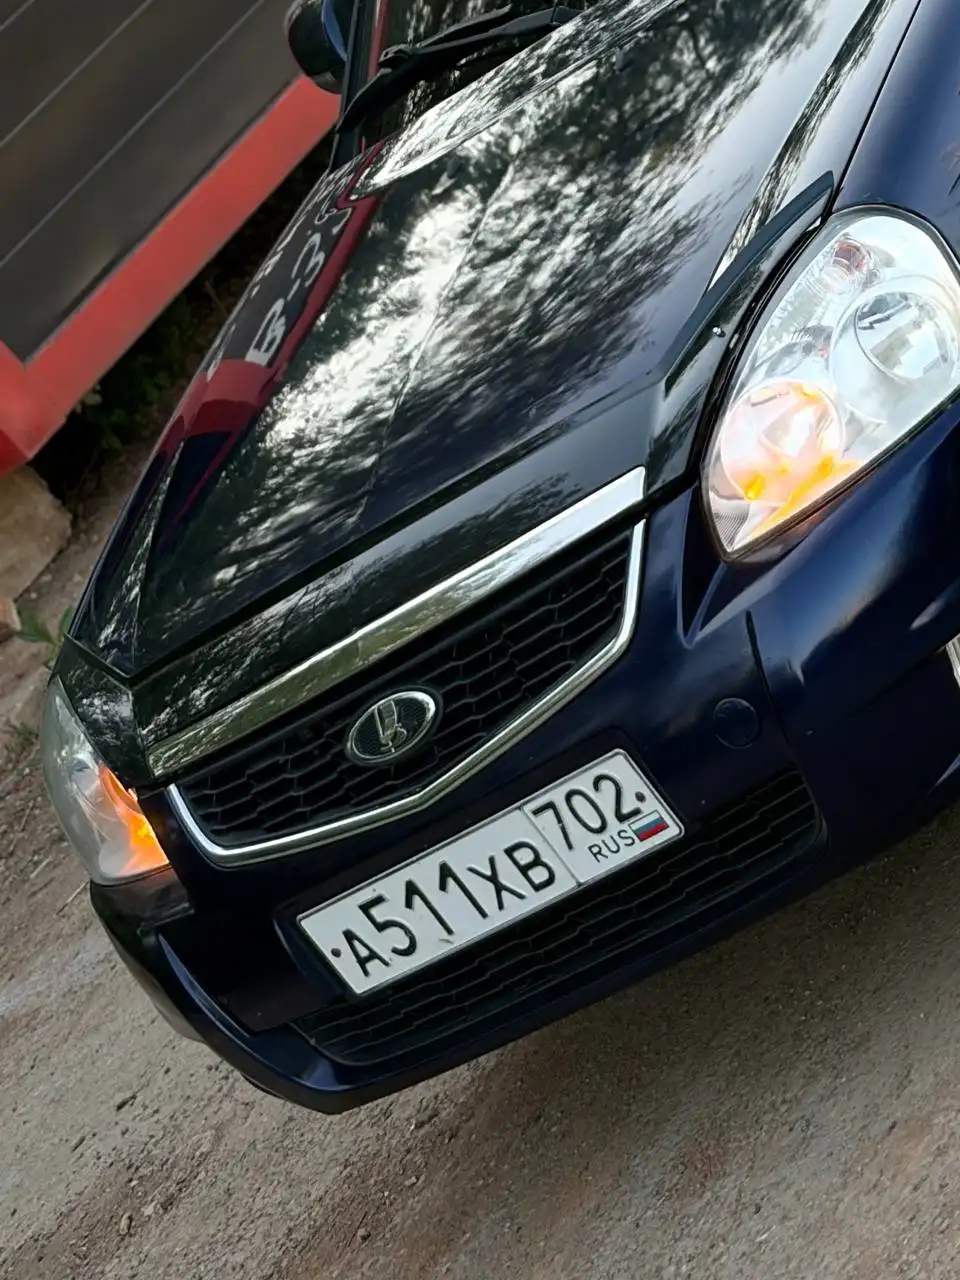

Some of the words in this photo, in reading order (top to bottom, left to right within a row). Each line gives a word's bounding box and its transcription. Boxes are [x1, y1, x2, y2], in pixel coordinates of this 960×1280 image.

[341, 840, 556, 977] A511XB
[531, 773, 643, 852] 702
[587, 828, 637, 863] RUS
